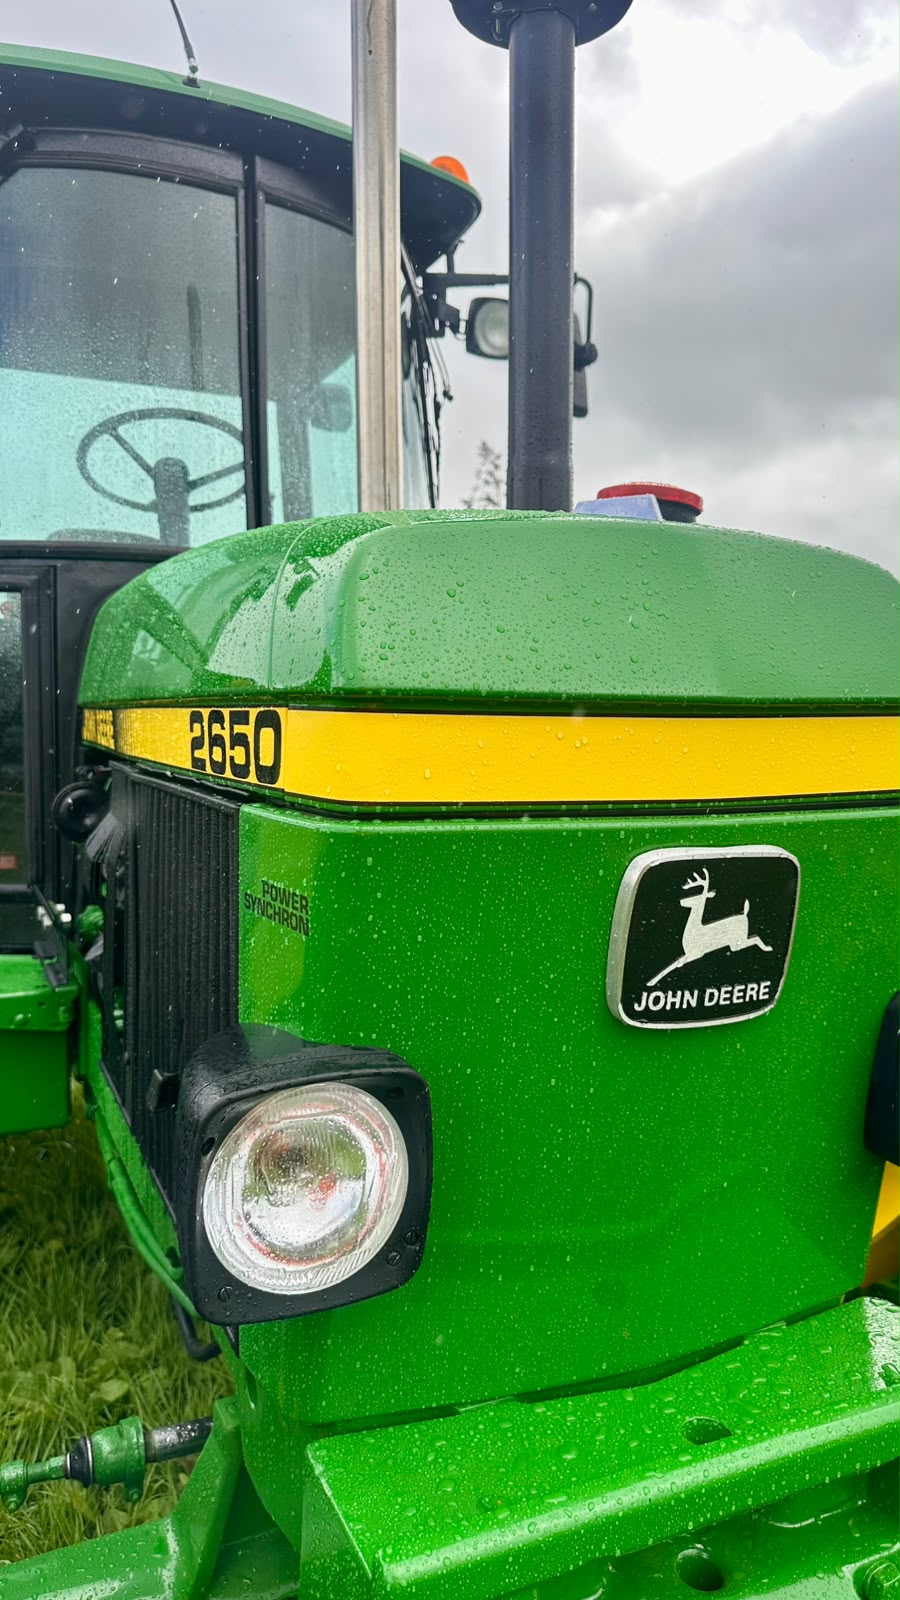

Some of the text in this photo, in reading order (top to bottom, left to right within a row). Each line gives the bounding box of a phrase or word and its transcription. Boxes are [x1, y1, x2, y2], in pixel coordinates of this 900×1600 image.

[190, 710, 281, 783] 2650
[244, 892, 309, 936] SYNCHRON
[262, 880, 309, 915] POWER
[634, 981, 771, 1011] JOHN DEERE
